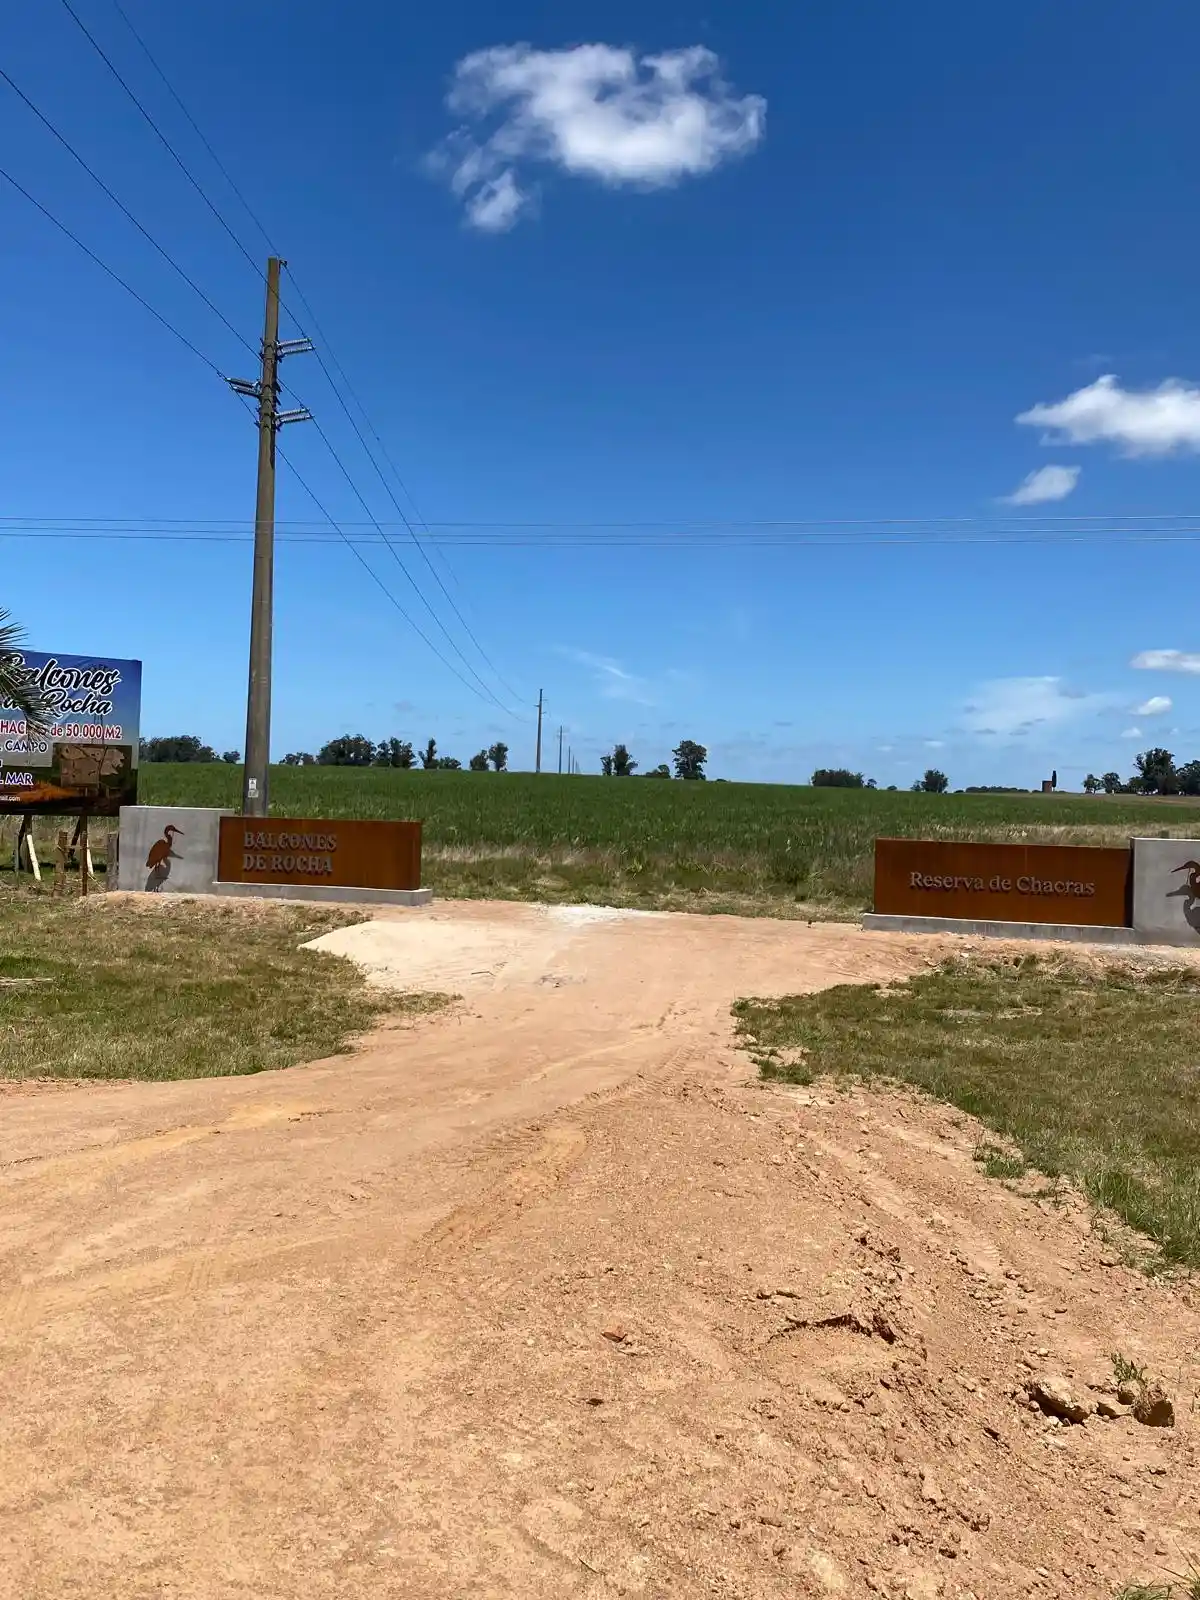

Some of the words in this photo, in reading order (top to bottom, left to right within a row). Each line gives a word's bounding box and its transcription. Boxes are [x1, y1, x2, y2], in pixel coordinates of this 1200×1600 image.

[41, 688, 113, 718] Rocha
[50, 723, 63, 737] de
[66, 724, 102, 739] 50.000
[104, 725, 122, 739] M2
[5, 739, 48, 753] CAMPO
[5, 771, 34, 785] MAR
[243, 831, 337, 850] BALCONES
[243, 854, 267, 870] DE
[271, 855, 333, 873] ROCHA
[909, 871, 984, 890] Reserva
[988, 874, 1012, 891] de
[1016, 876, 1095, 895] Chacras
